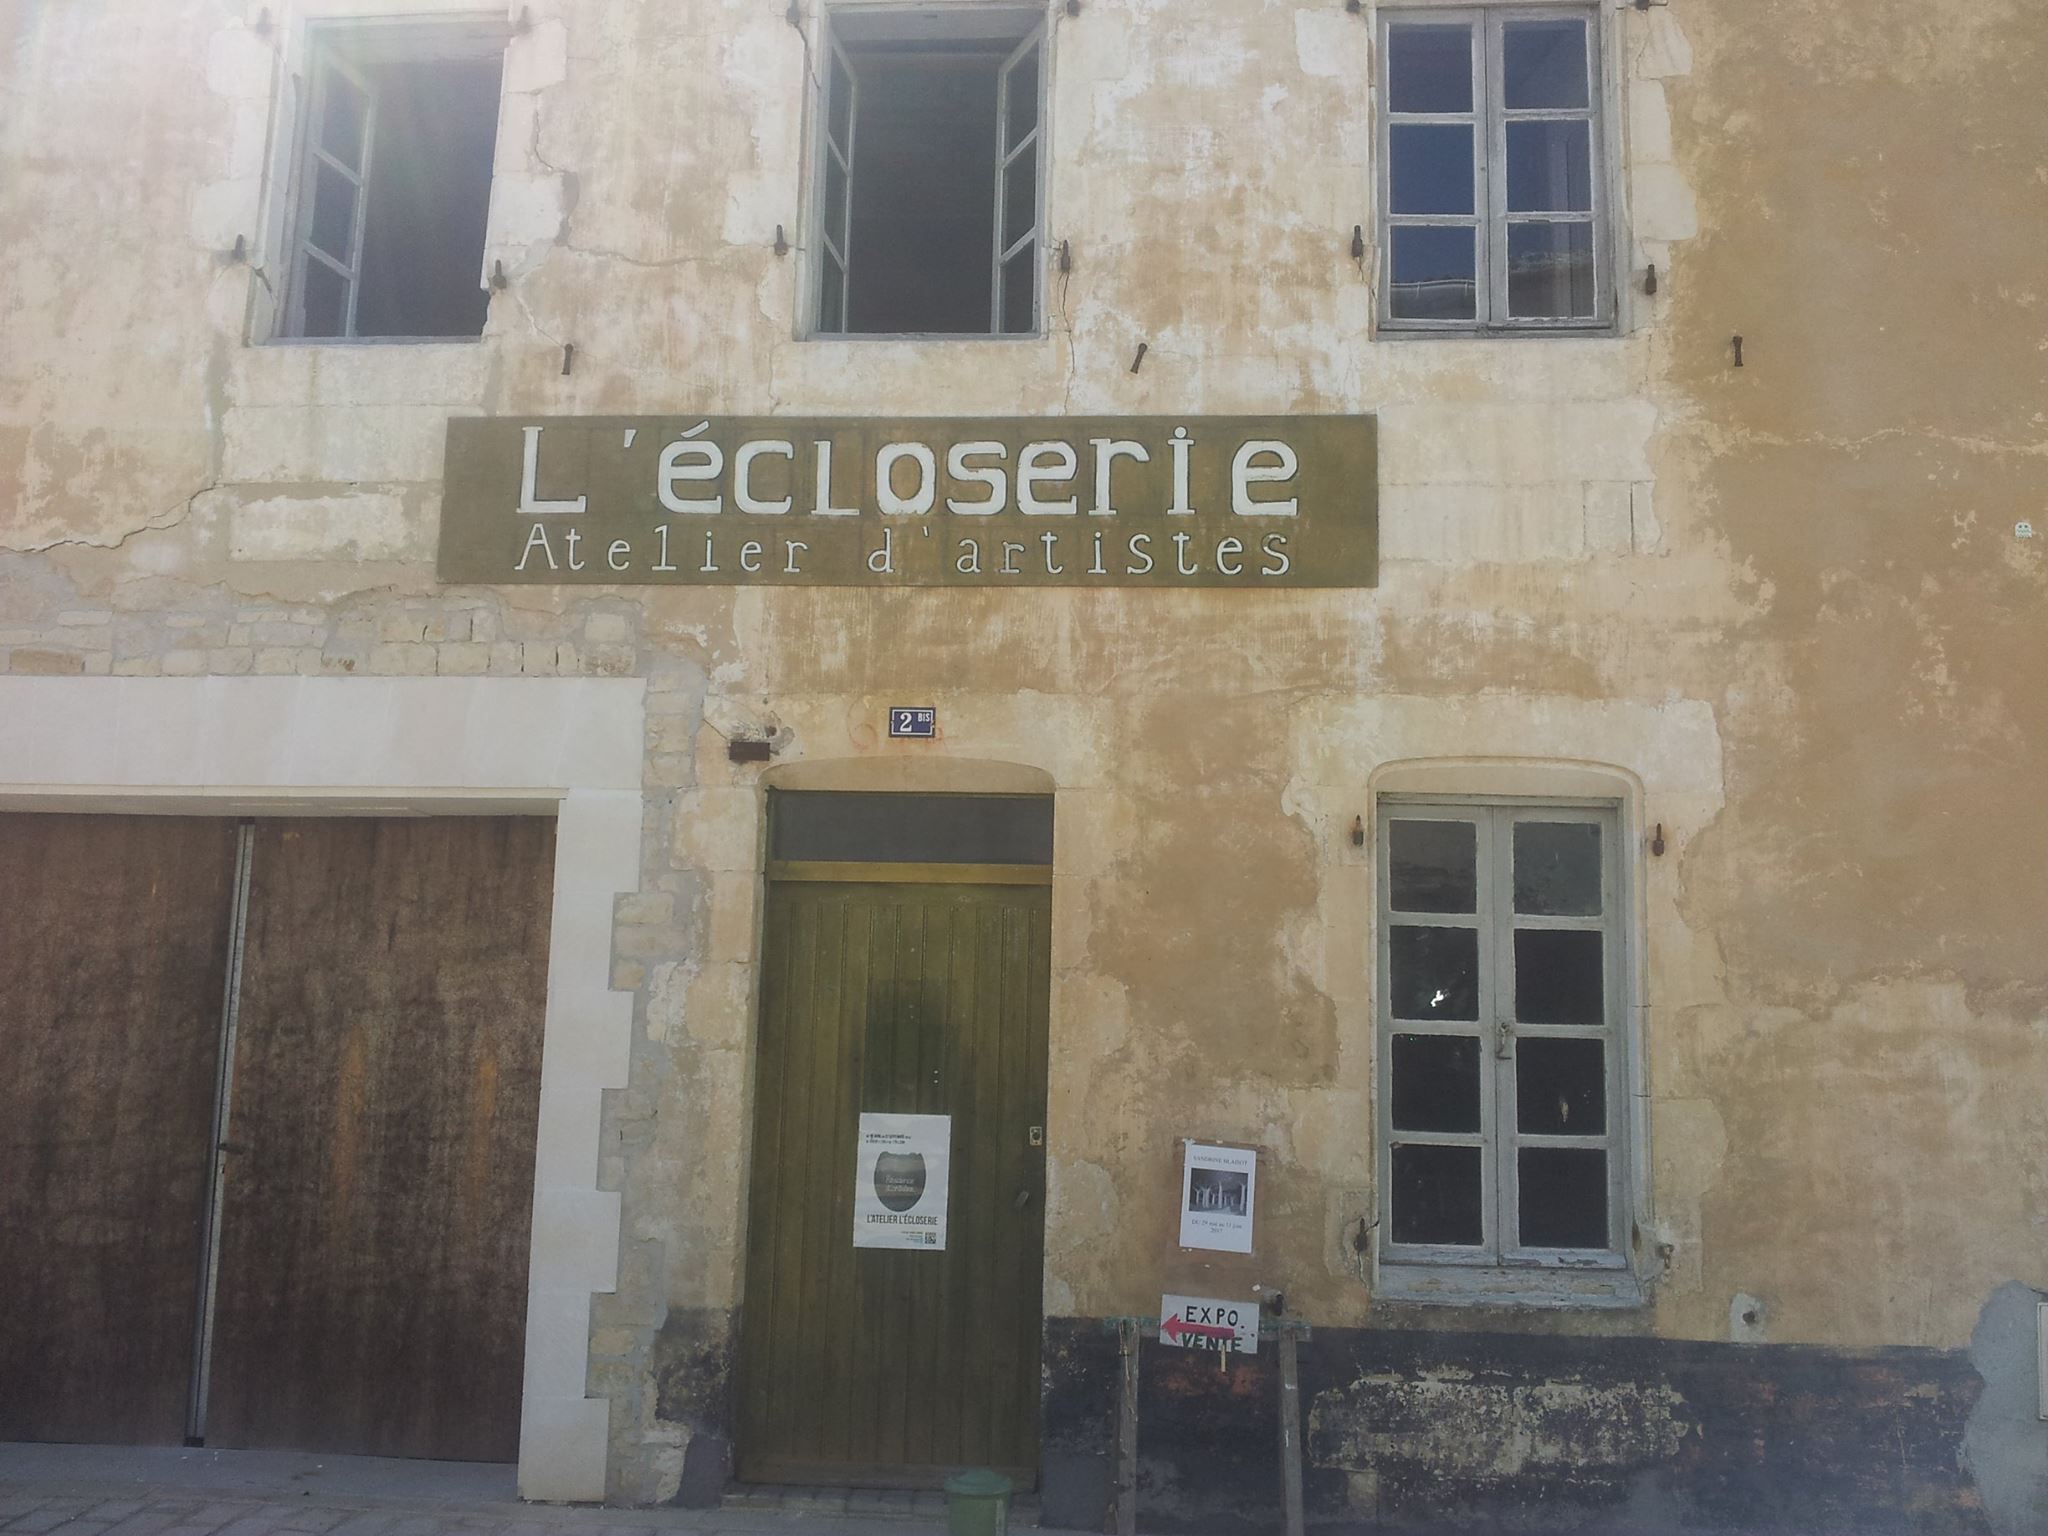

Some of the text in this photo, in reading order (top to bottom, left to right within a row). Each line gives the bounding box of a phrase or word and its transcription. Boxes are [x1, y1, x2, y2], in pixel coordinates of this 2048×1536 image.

[514, 523, 1290, 576] Atelier d'artistes
[899, 712, 930, 732] 2 BIS
[867, 1213, 938, 1226] L'ATELIER L'ÉCLOSERIE
